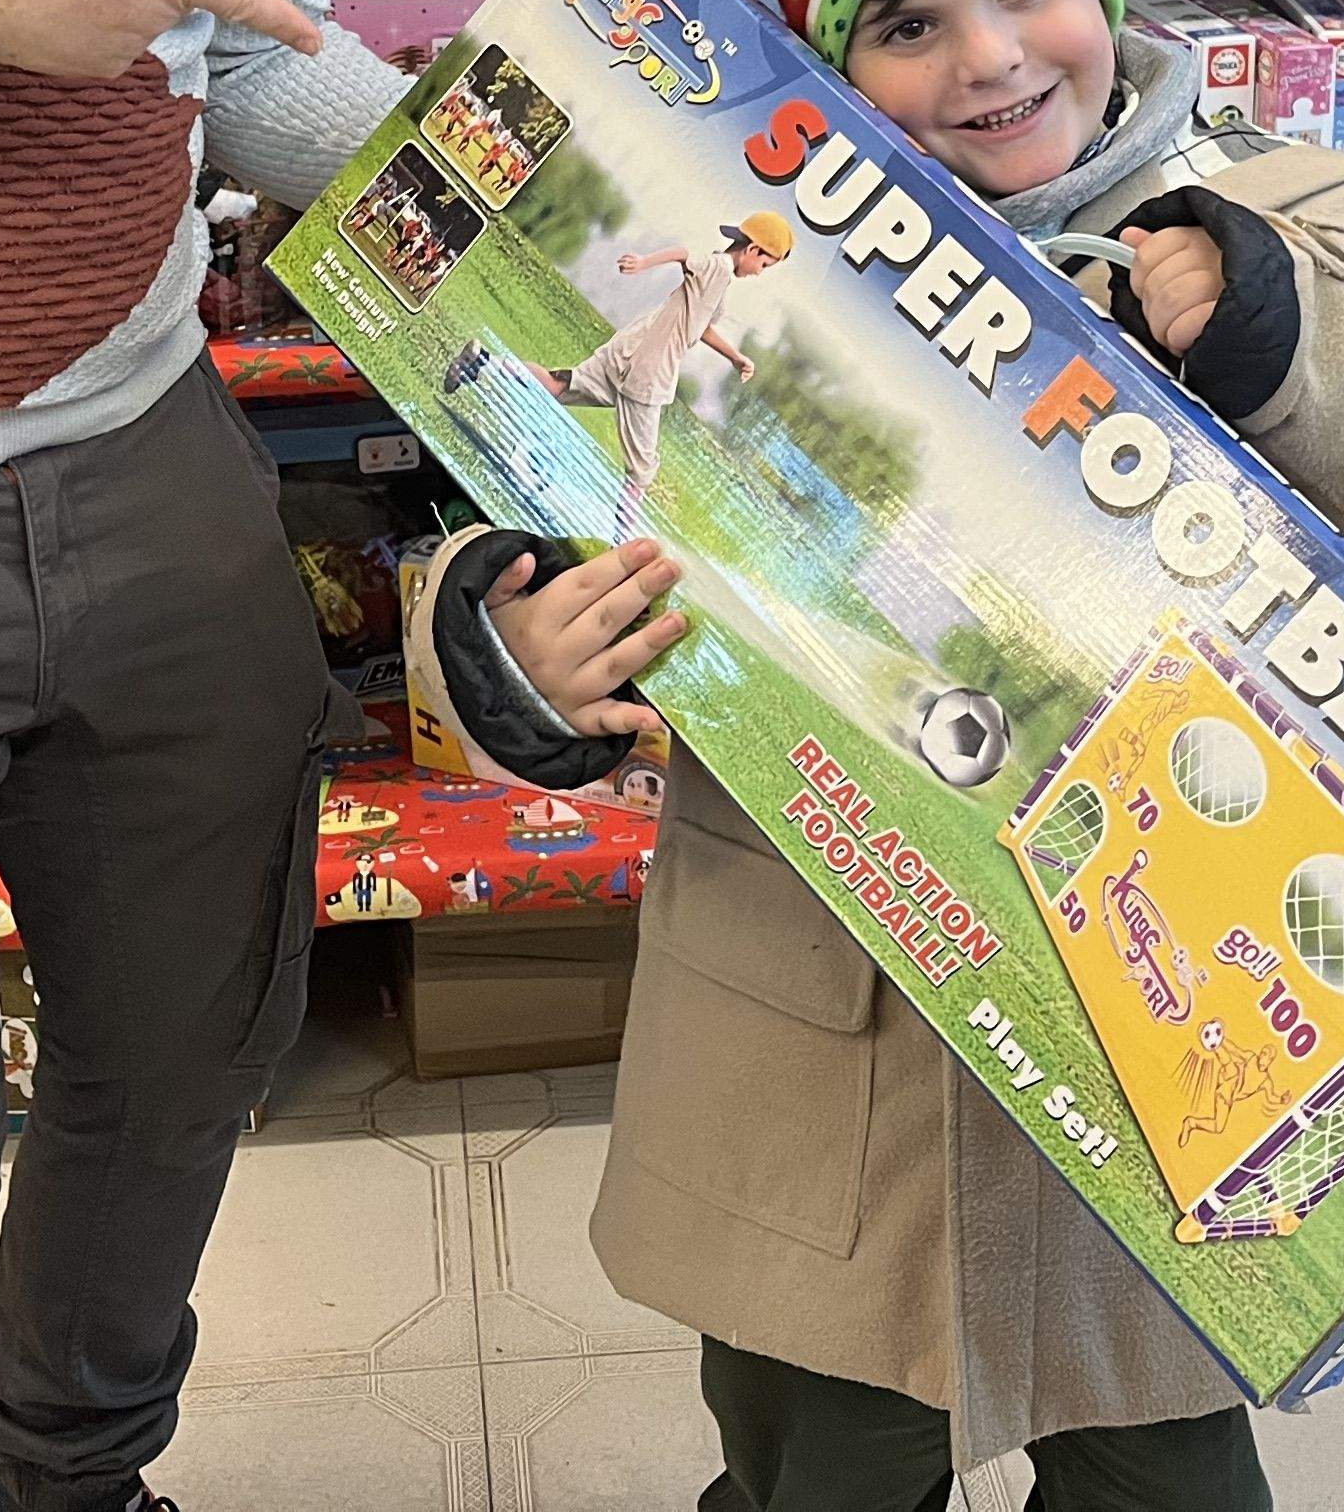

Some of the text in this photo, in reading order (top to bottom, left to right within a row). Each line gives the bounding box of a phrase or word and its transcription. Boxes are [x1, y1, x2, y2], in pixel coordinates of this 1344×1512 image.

[744, 98, 1033, 390] SUPER
[310, 262, 382, 343] New Design!
[320, 245, 398, 335] New Century!
[787, 733, 1005, 968] REAL ACTION
[1126, 787, 1159, 833] 70
[781, 788, 962, 988] FOOTBALL!
[1058, 889, 1087, 934] 50
[1255, 979, 1319, 1061] 100
[967, 997, 1120, 1169] Play Set!
